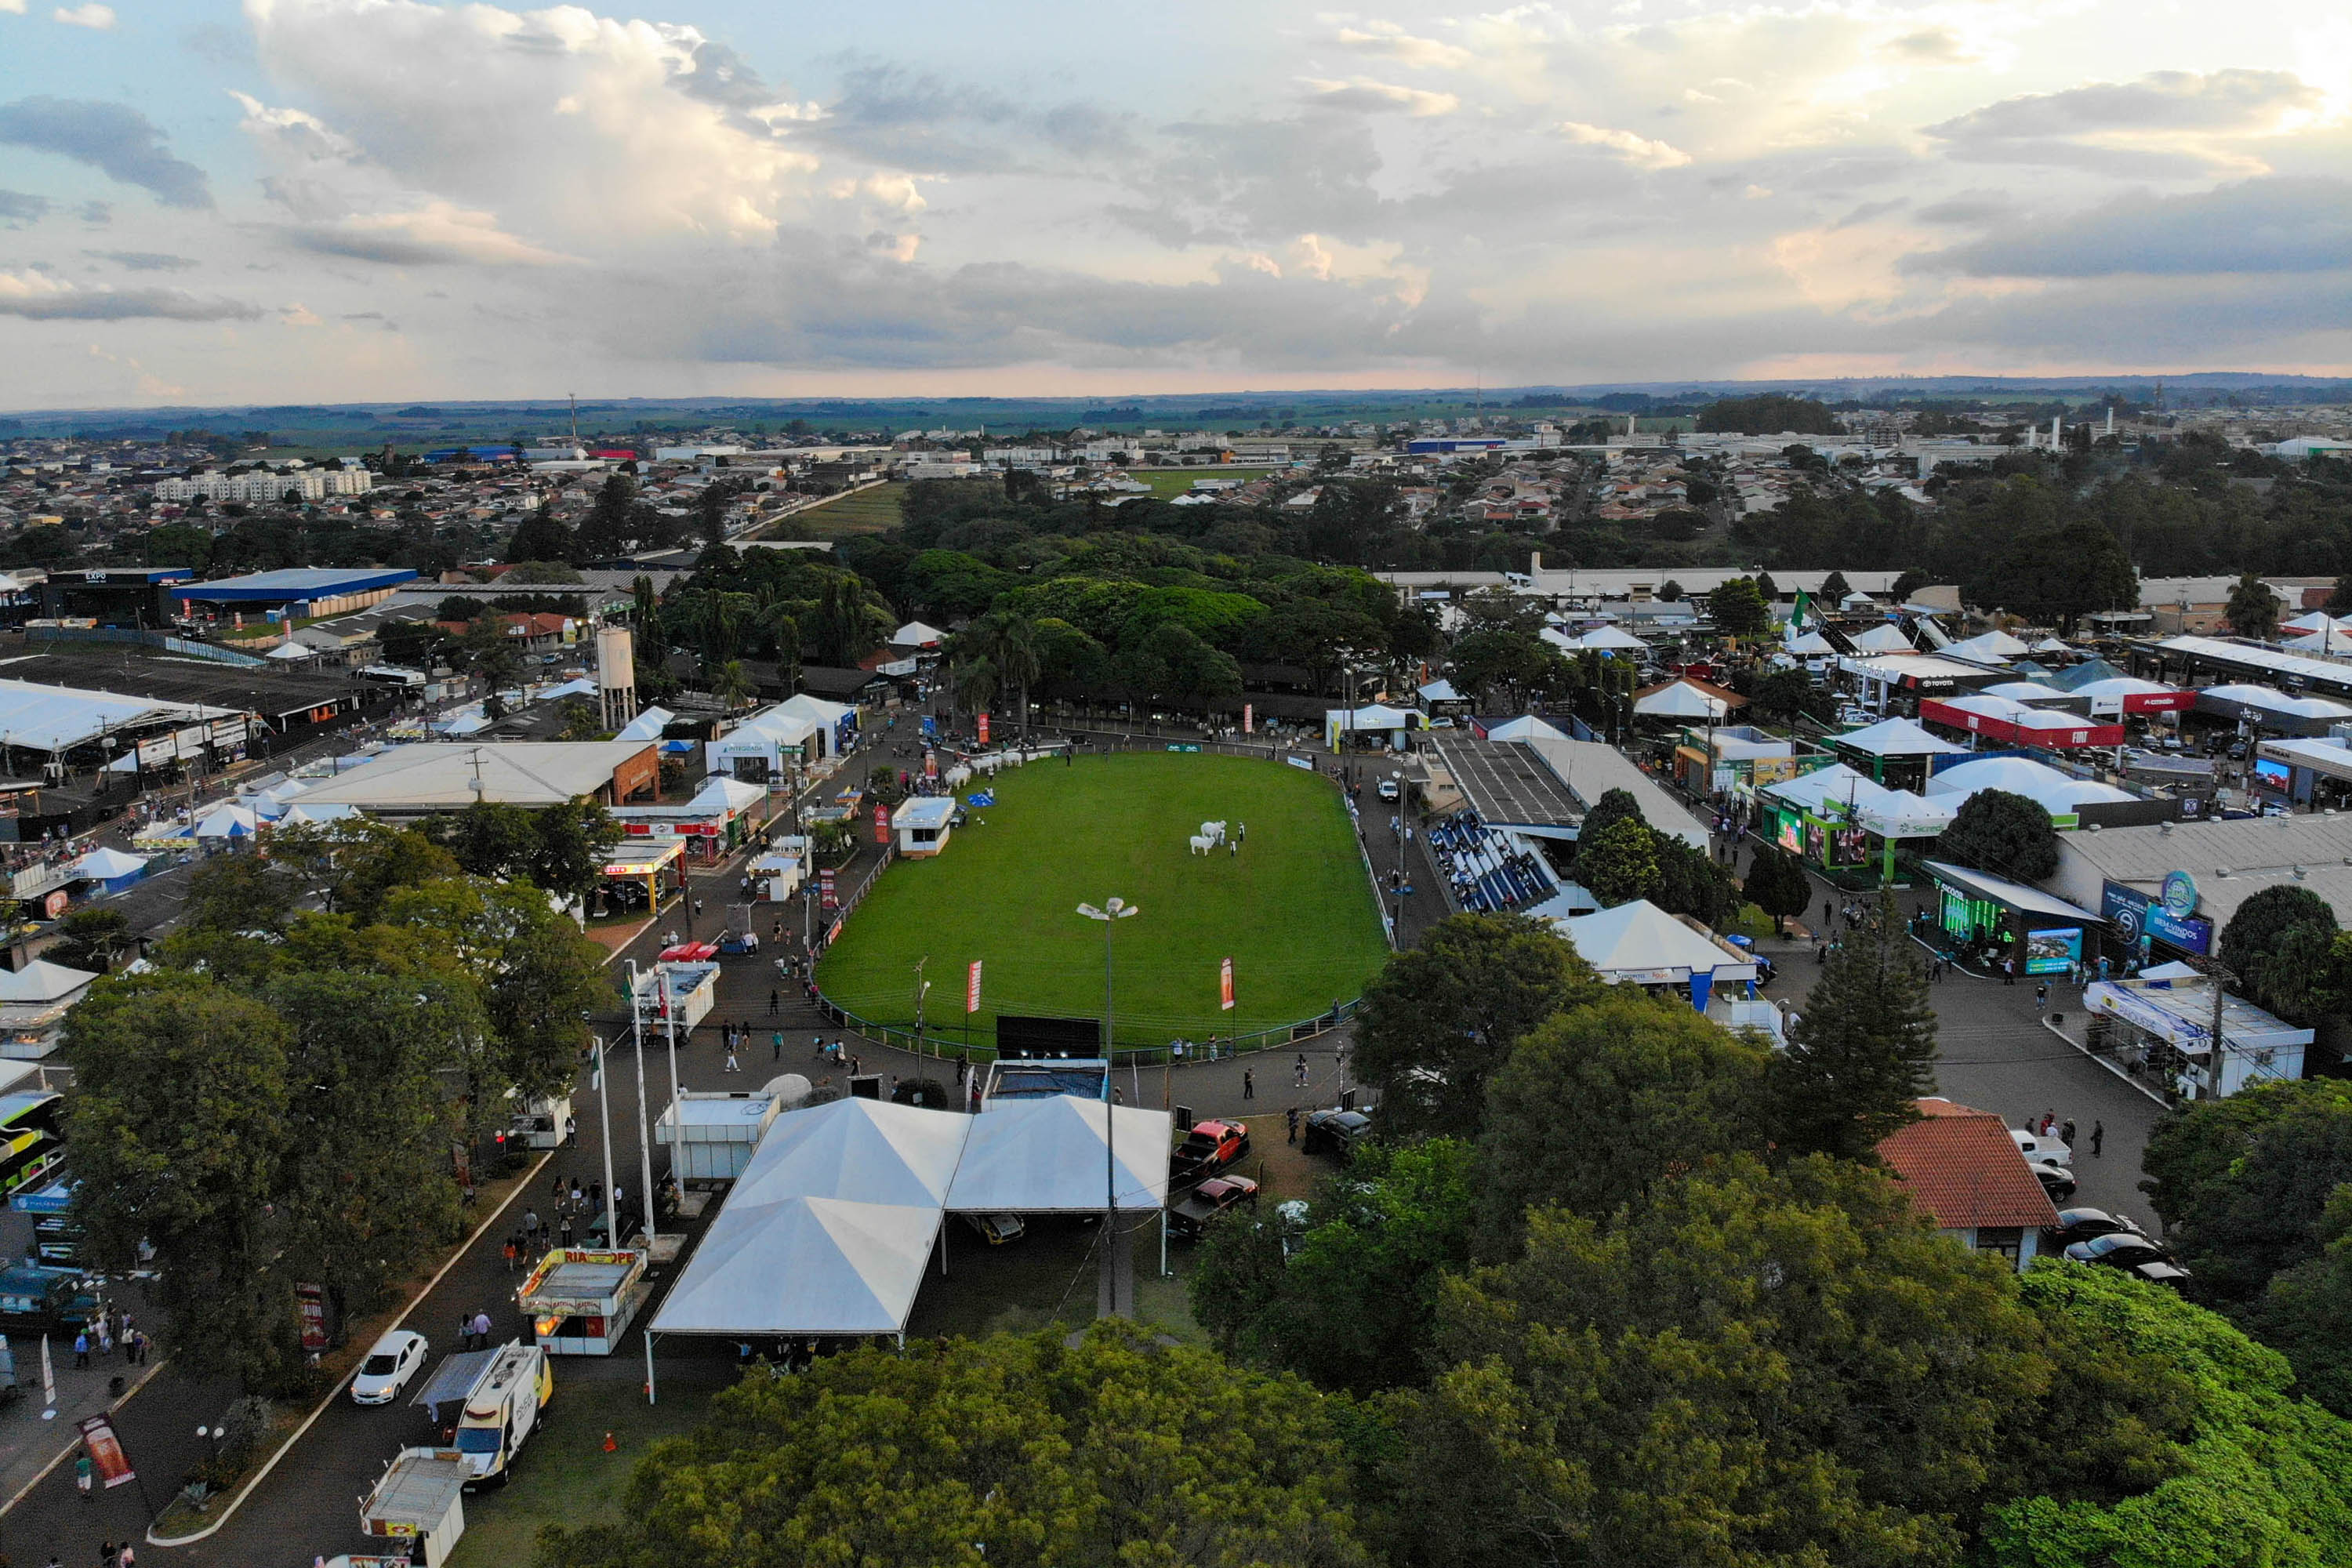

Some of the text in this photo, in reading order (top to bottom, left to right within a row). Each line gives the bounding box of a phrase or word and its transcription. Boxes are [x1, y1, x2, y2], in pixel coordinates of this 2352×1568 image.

[1864, 666, 1886, 679] TOYOTA
[2071, 731, 2089, 744] FIAT
[2264, 747, 2289, 758] NISSAN
[1941, 883, 1964, 902] SICOOB
[2154, 917, 2198, 940] BEM-VINDOS
[971, 960, 982, 1012] BRAHMA
